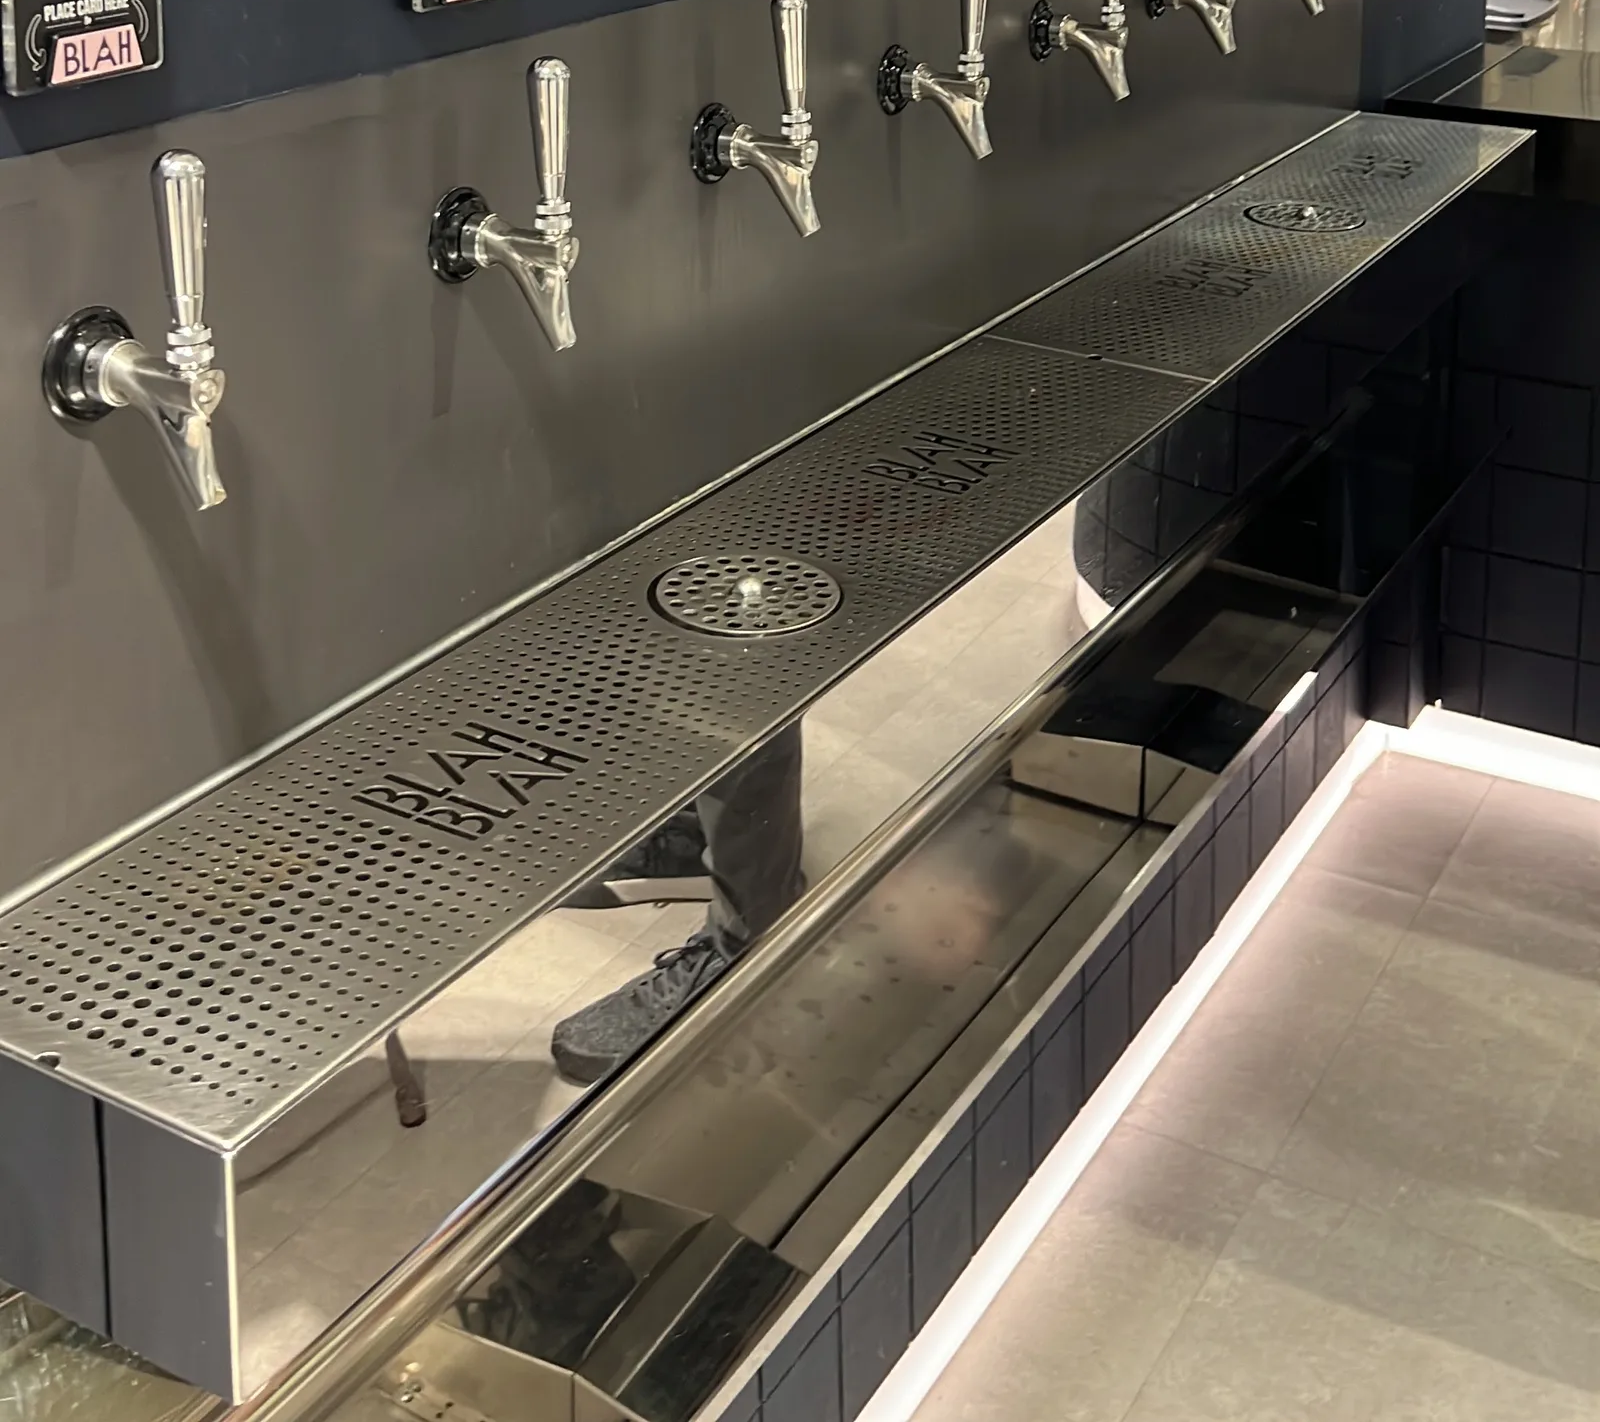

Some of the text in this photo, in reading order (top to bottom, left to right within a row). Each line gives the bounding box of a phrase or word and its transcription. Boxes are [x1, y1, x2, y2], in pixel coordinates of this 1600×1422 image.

[43, 1, 76, 22] PLACE
[63, 29, 132, 77] BLAH
[861, 431, 968, 483] BLAH
[913, 443, 1021, 495] BLAH
[351, 721, 527, 819] BLAH
[414, 742, 590, 841] BLAH
